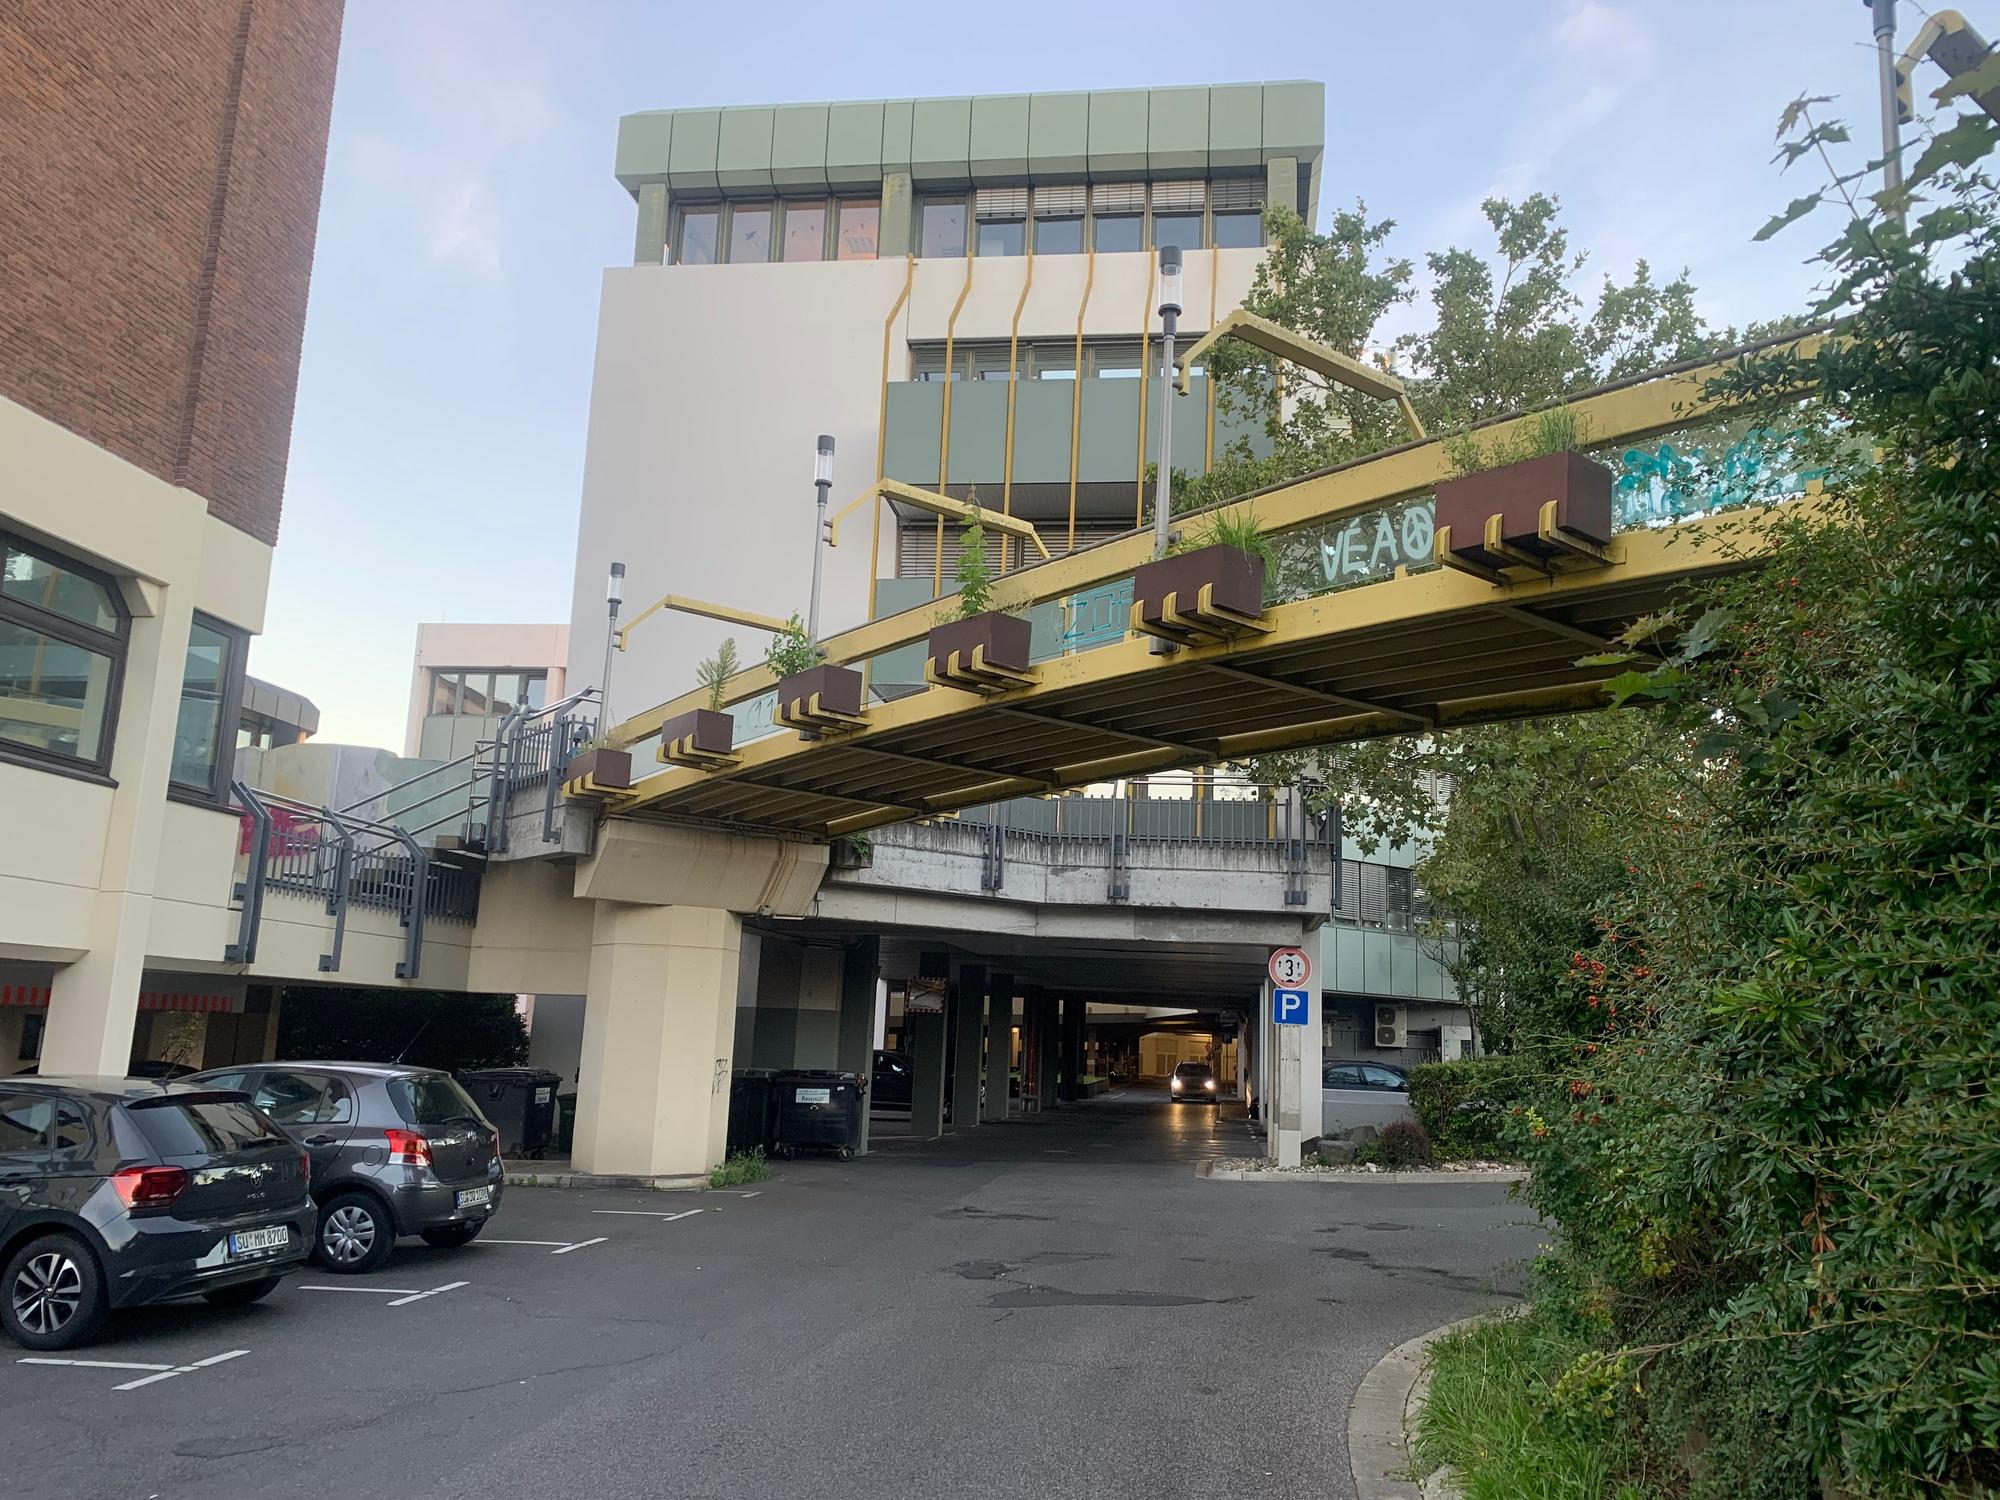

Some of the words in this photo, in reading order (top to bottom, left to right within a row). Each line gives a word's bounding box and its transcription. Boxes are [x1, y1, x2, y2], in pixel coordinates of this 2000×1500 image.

[1285, 959, 1294, 977] 3
[1281, 993, 1301, 1020] P
[236, 1233, 249, 1250] SU
[254, 1230, 266, 1247] MM
[267, 1228, 287, 1244] 8700
